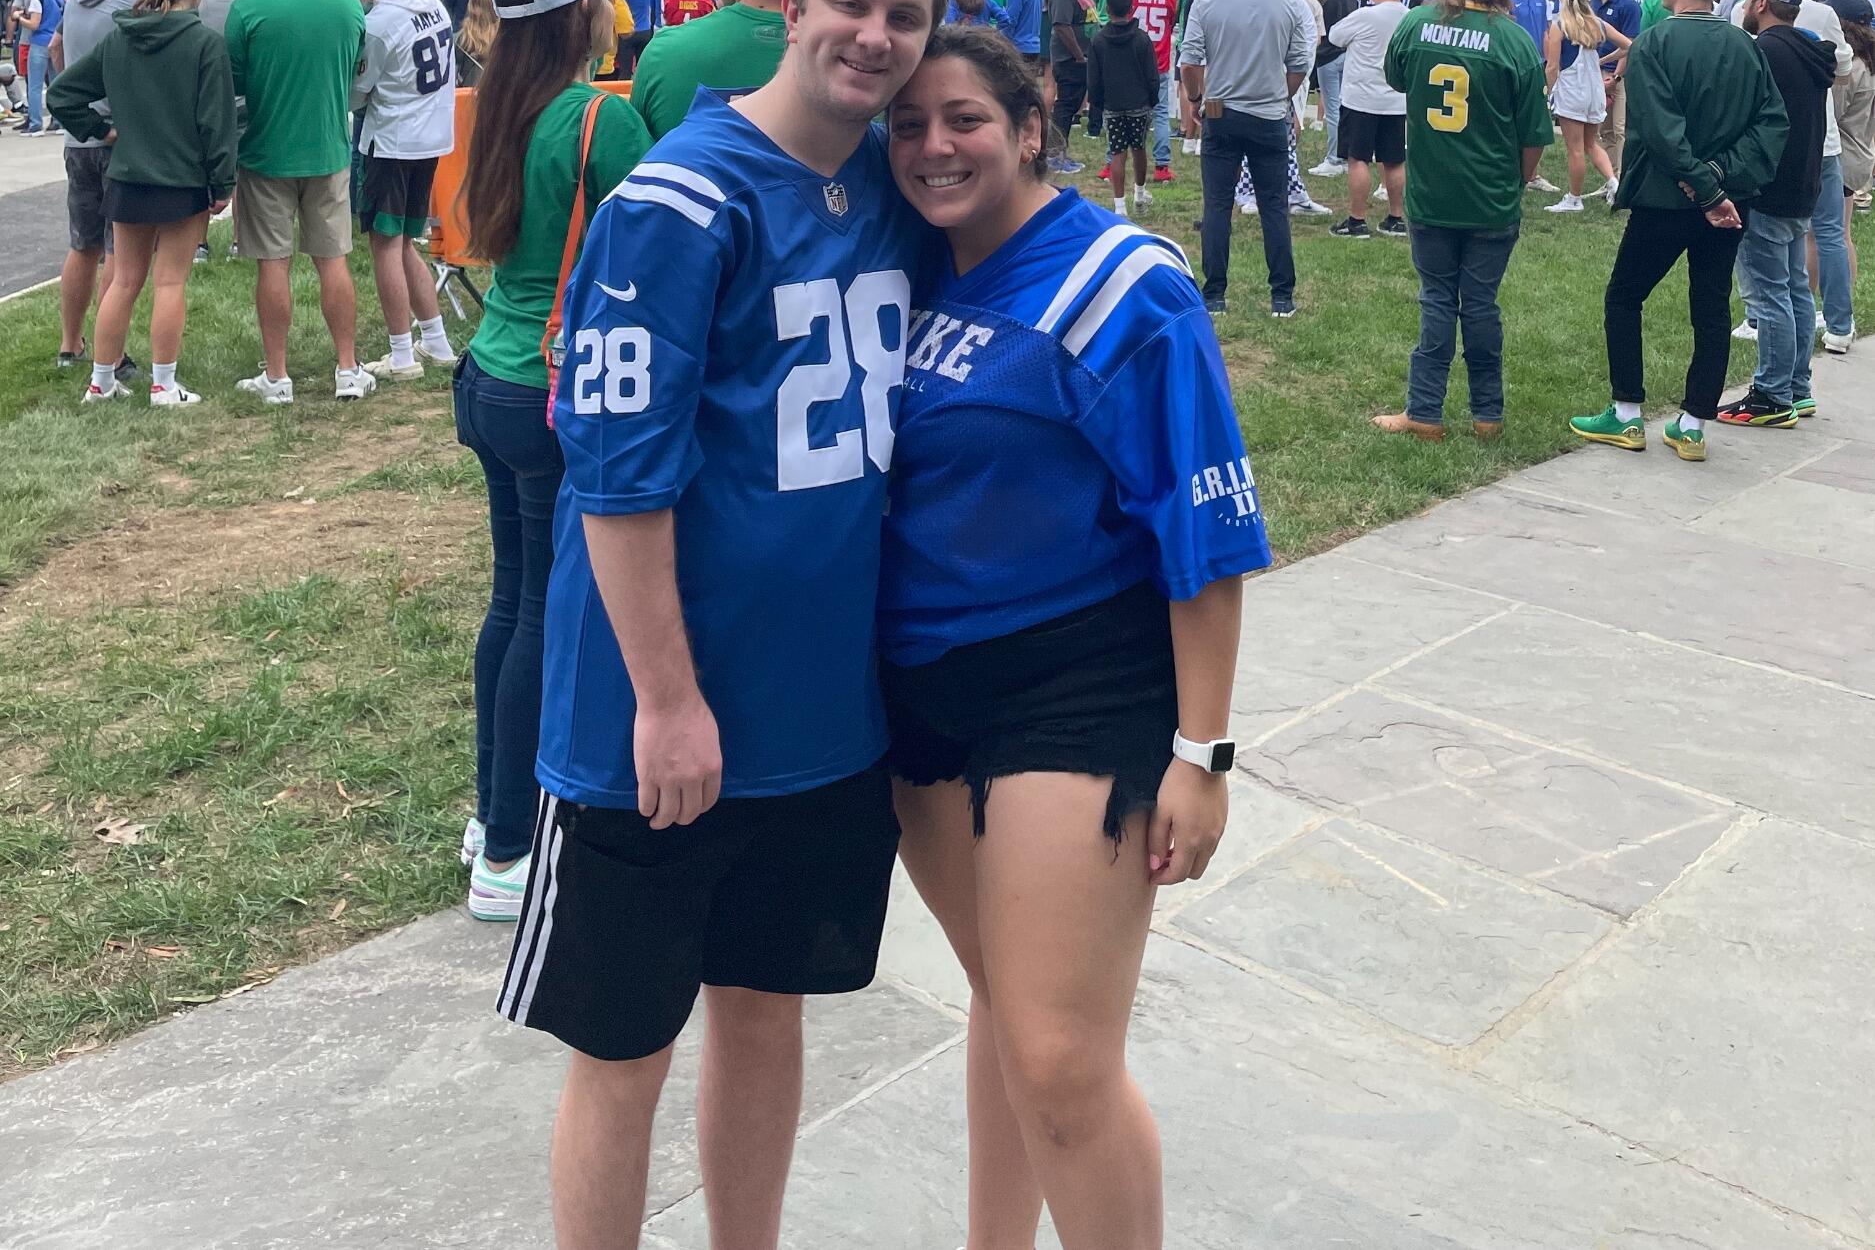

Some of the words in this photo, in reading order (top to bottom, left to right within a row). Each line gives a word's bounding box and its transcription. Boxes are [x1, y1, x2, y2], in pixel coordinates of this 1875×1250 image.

[411, 9, 443, 33] MAYER
[1420, 23, 1490, 52] MONTANA
[412, 26, 453, 95] 87
[1426, 63, 1470, 133] 3
[574, 327, 651, 415] 28
[772, 269, 911, 492] 28
[906, 309, 995, 383] KE
